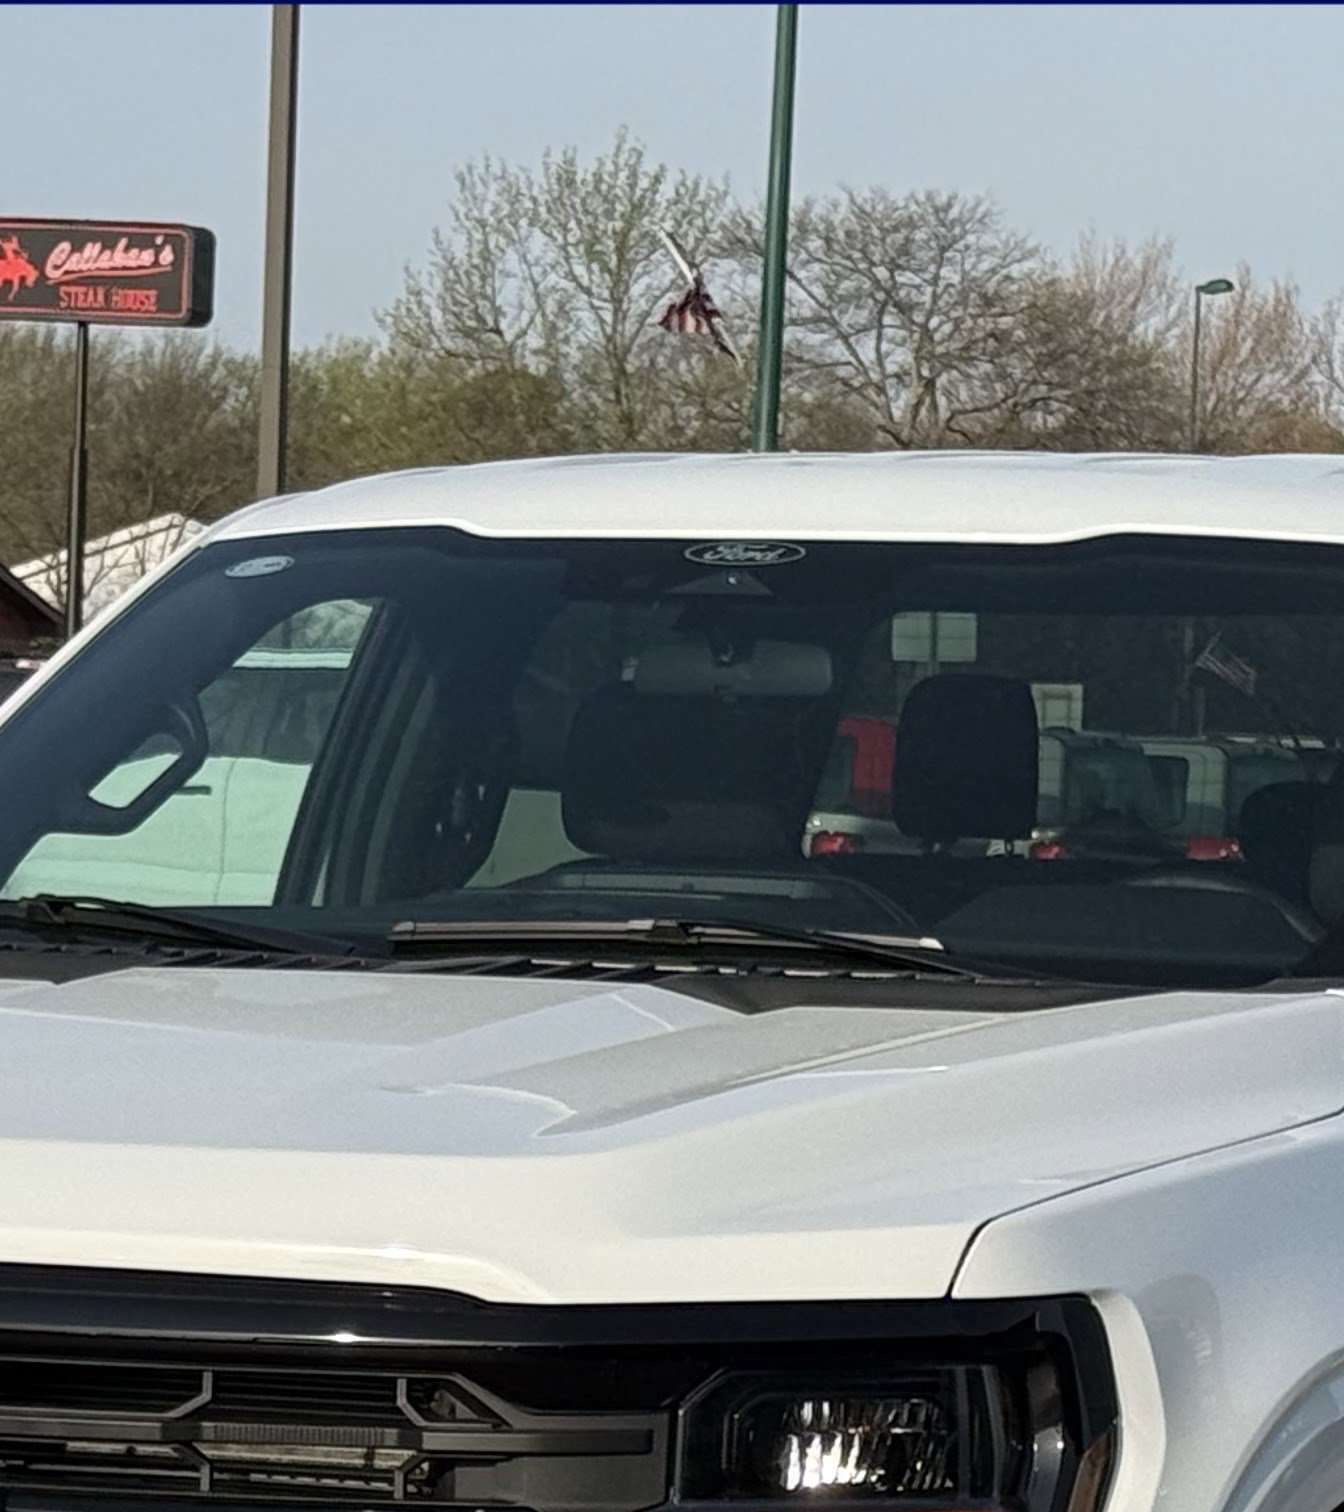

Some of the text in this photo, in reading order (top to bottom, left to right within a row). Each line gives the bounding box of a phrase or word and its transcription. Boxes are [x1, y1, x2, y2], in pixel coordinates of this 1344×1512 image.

[59, 285, 159, 312] STEAK HOUSE
[702, 543, 787, 561] Ford
